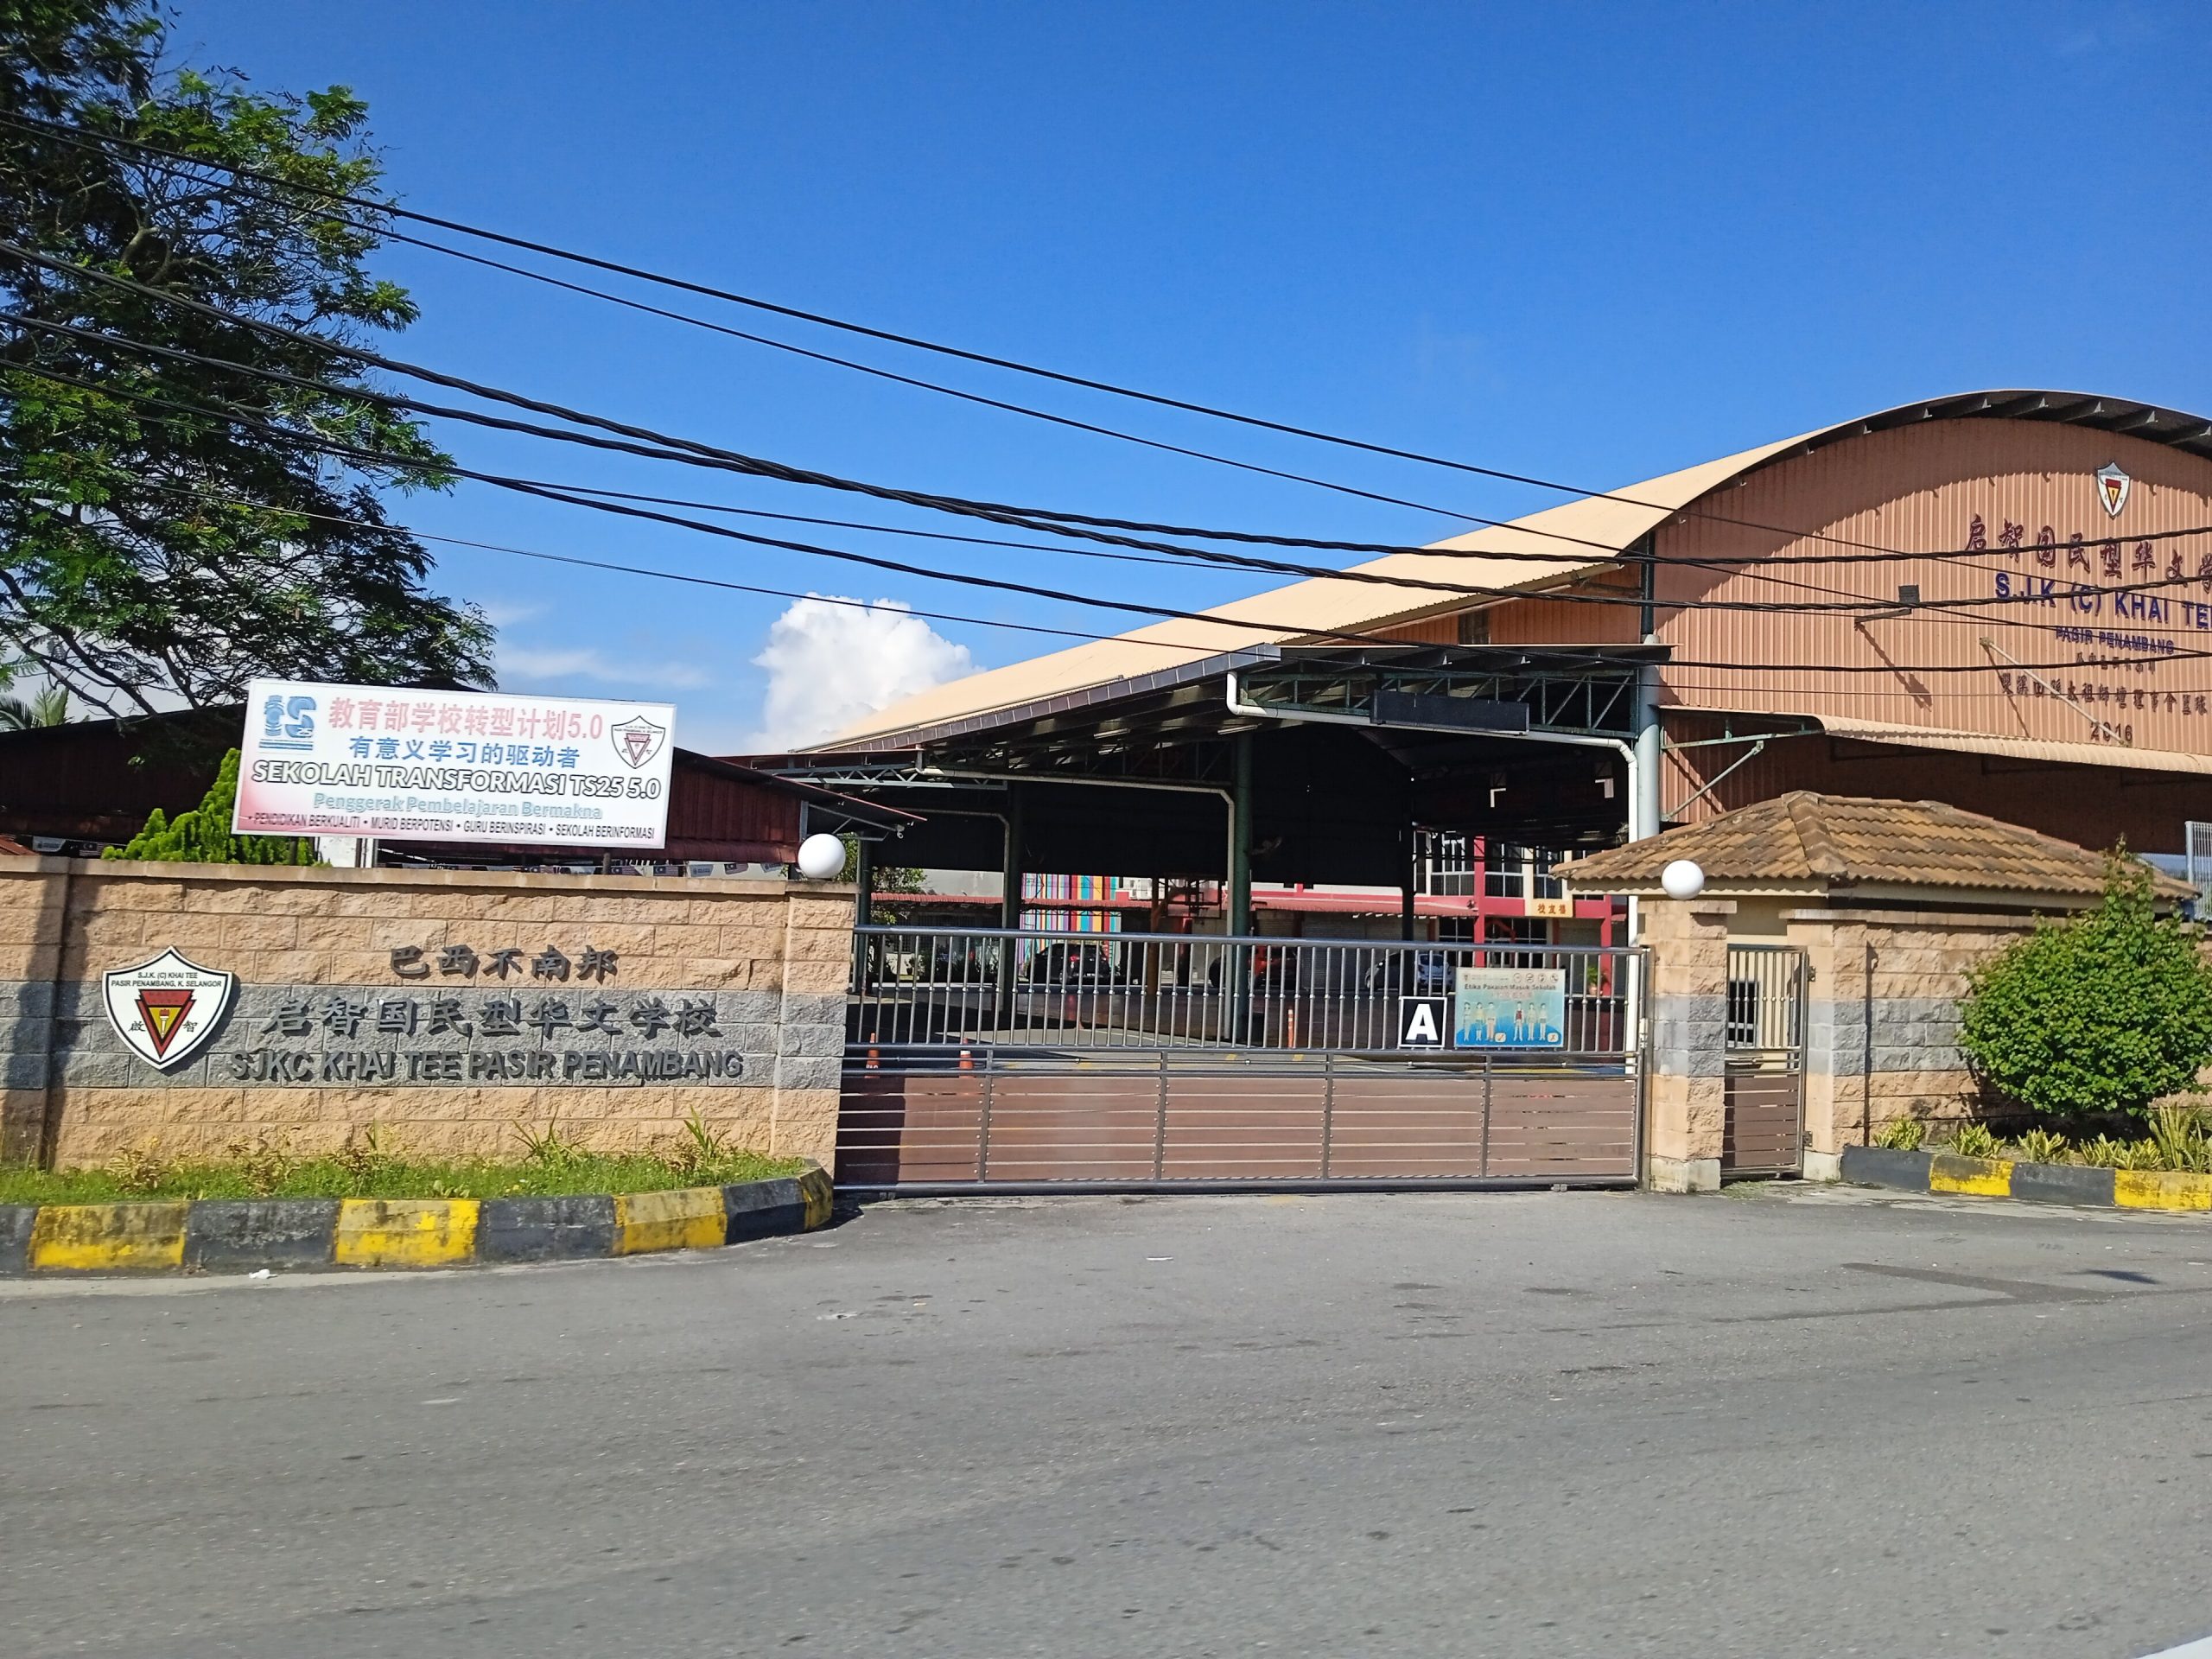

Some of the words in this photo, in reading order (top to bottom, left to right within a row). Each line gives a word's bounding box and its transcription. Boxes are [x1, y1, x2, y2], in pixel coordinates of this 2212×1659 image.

[2115, 590, 2169, 624] KHAI
[2182, 601, 2212, 630] TE
[2056, 626, 2093, 645] PASIR
[2099, 631, 2175, 655] PENAMBANG
[327, 696, 603, 741] 教育部学校转型计划5.0
[2090, 721, 2133, 742] 2016
[349, 735, 580, 768] 有意义学习的驱动者
[251, 760, 372, 787] SEKOLAH
[375, 765, 567, 796] TRANSFORMASI
[570, 774, 624, 798] TS25
[626, 778, 662, 799] 5.0
[314, 792, 404, 813] Penggerak
[406, 795, 518, 817] Pembelajaran
[521, 801, 603, 819] Bermakna
[253, 812, 306, 827] PENDIDIKAN
[308, 814, 360, 829] BERKUALITI
[371, 817, 397, 830] MURID
[399, 817, 453, 831] BERPOTENSI
[463, 820, 487, 833] GURU
[489, 821, 545, 836] BERINSPIRASI
[556, 823, 594, 837] SEKOLAH
[595, 824, 655, 839] BERINFORMASI
[391, 944, 616, 982] 巴西不南邦
[182, 1020, 199, 1033] 智
[262, 995, 723, 1039] 启智国民型华文学校
[1405, 1003, 1438, 1040] A
[229, 1050, 312, 1079] SJKC
[321, 1050, 395, 1079] KHAI
[404, 1050, 461, 1079] TEE
[467, 1049, 555, 1079] PASIR
[563, 1049, 743, 1079] PENAMBANG
